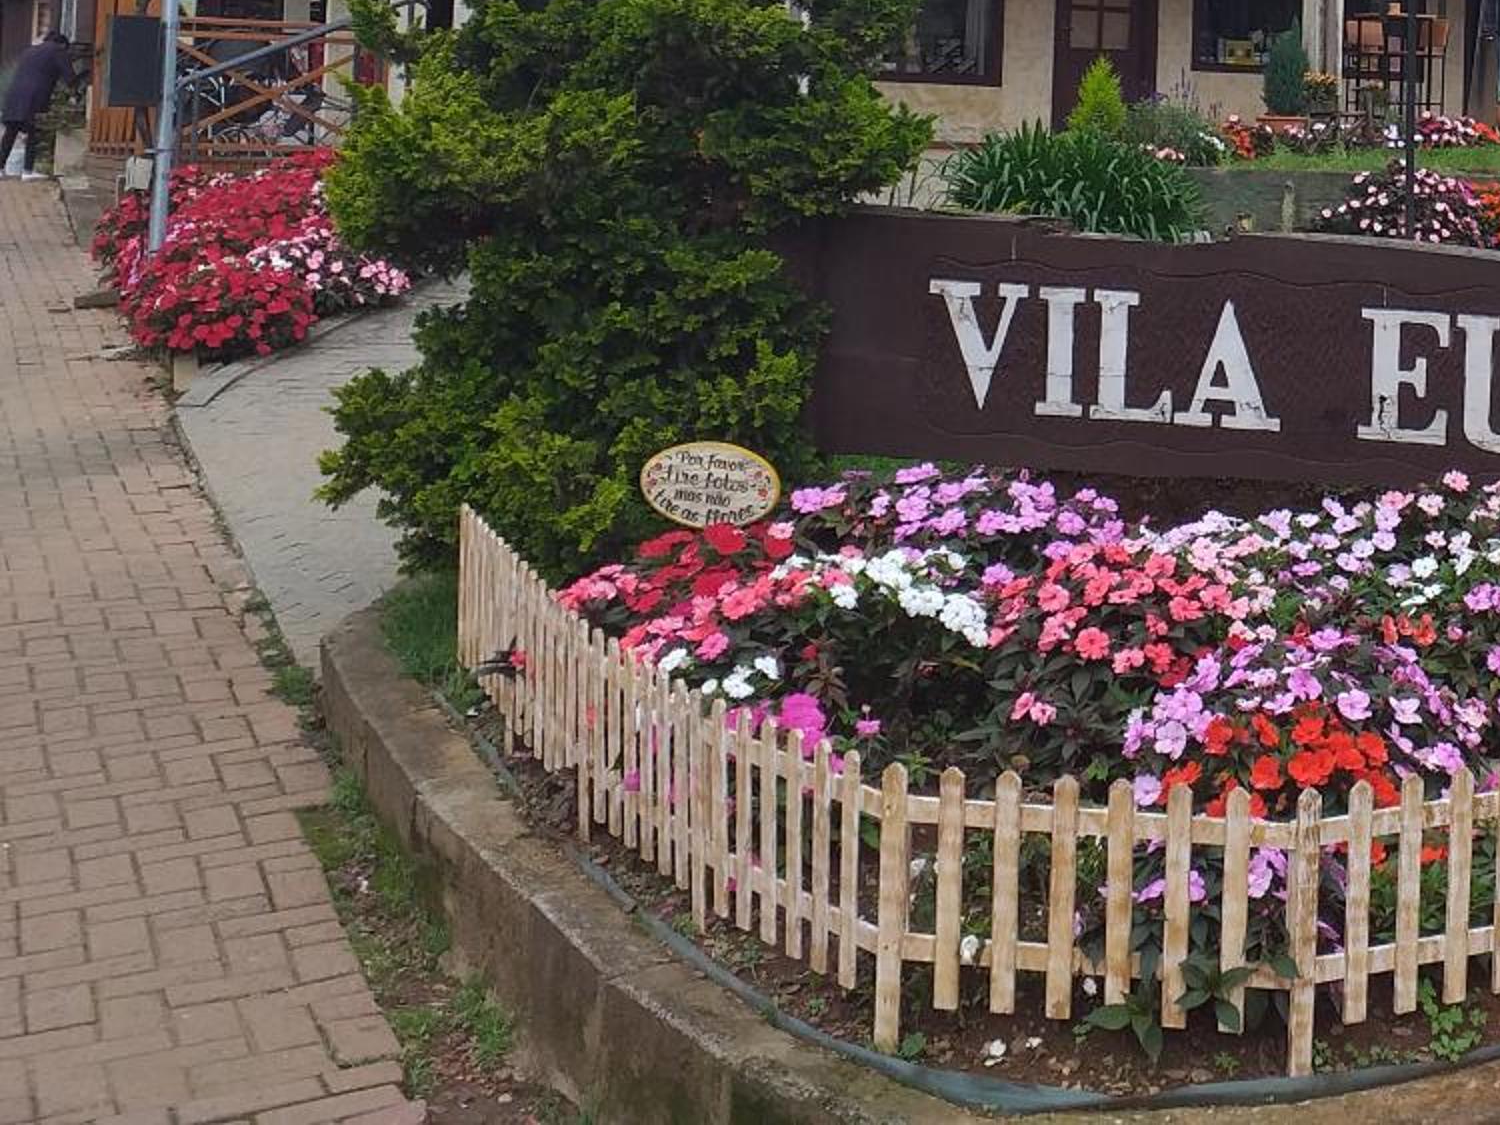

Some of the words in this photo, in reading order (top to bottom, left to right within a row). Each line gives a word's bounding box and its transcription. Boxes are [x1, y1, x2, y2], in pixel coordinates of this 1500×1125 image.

[929, 278, 1281, 432] VILA
[702, 472, 749, 493] fotos
[653, 489, 680, 515] tire
[681, 508, 699, 523] as
[673, 489, 703, 504] mas
